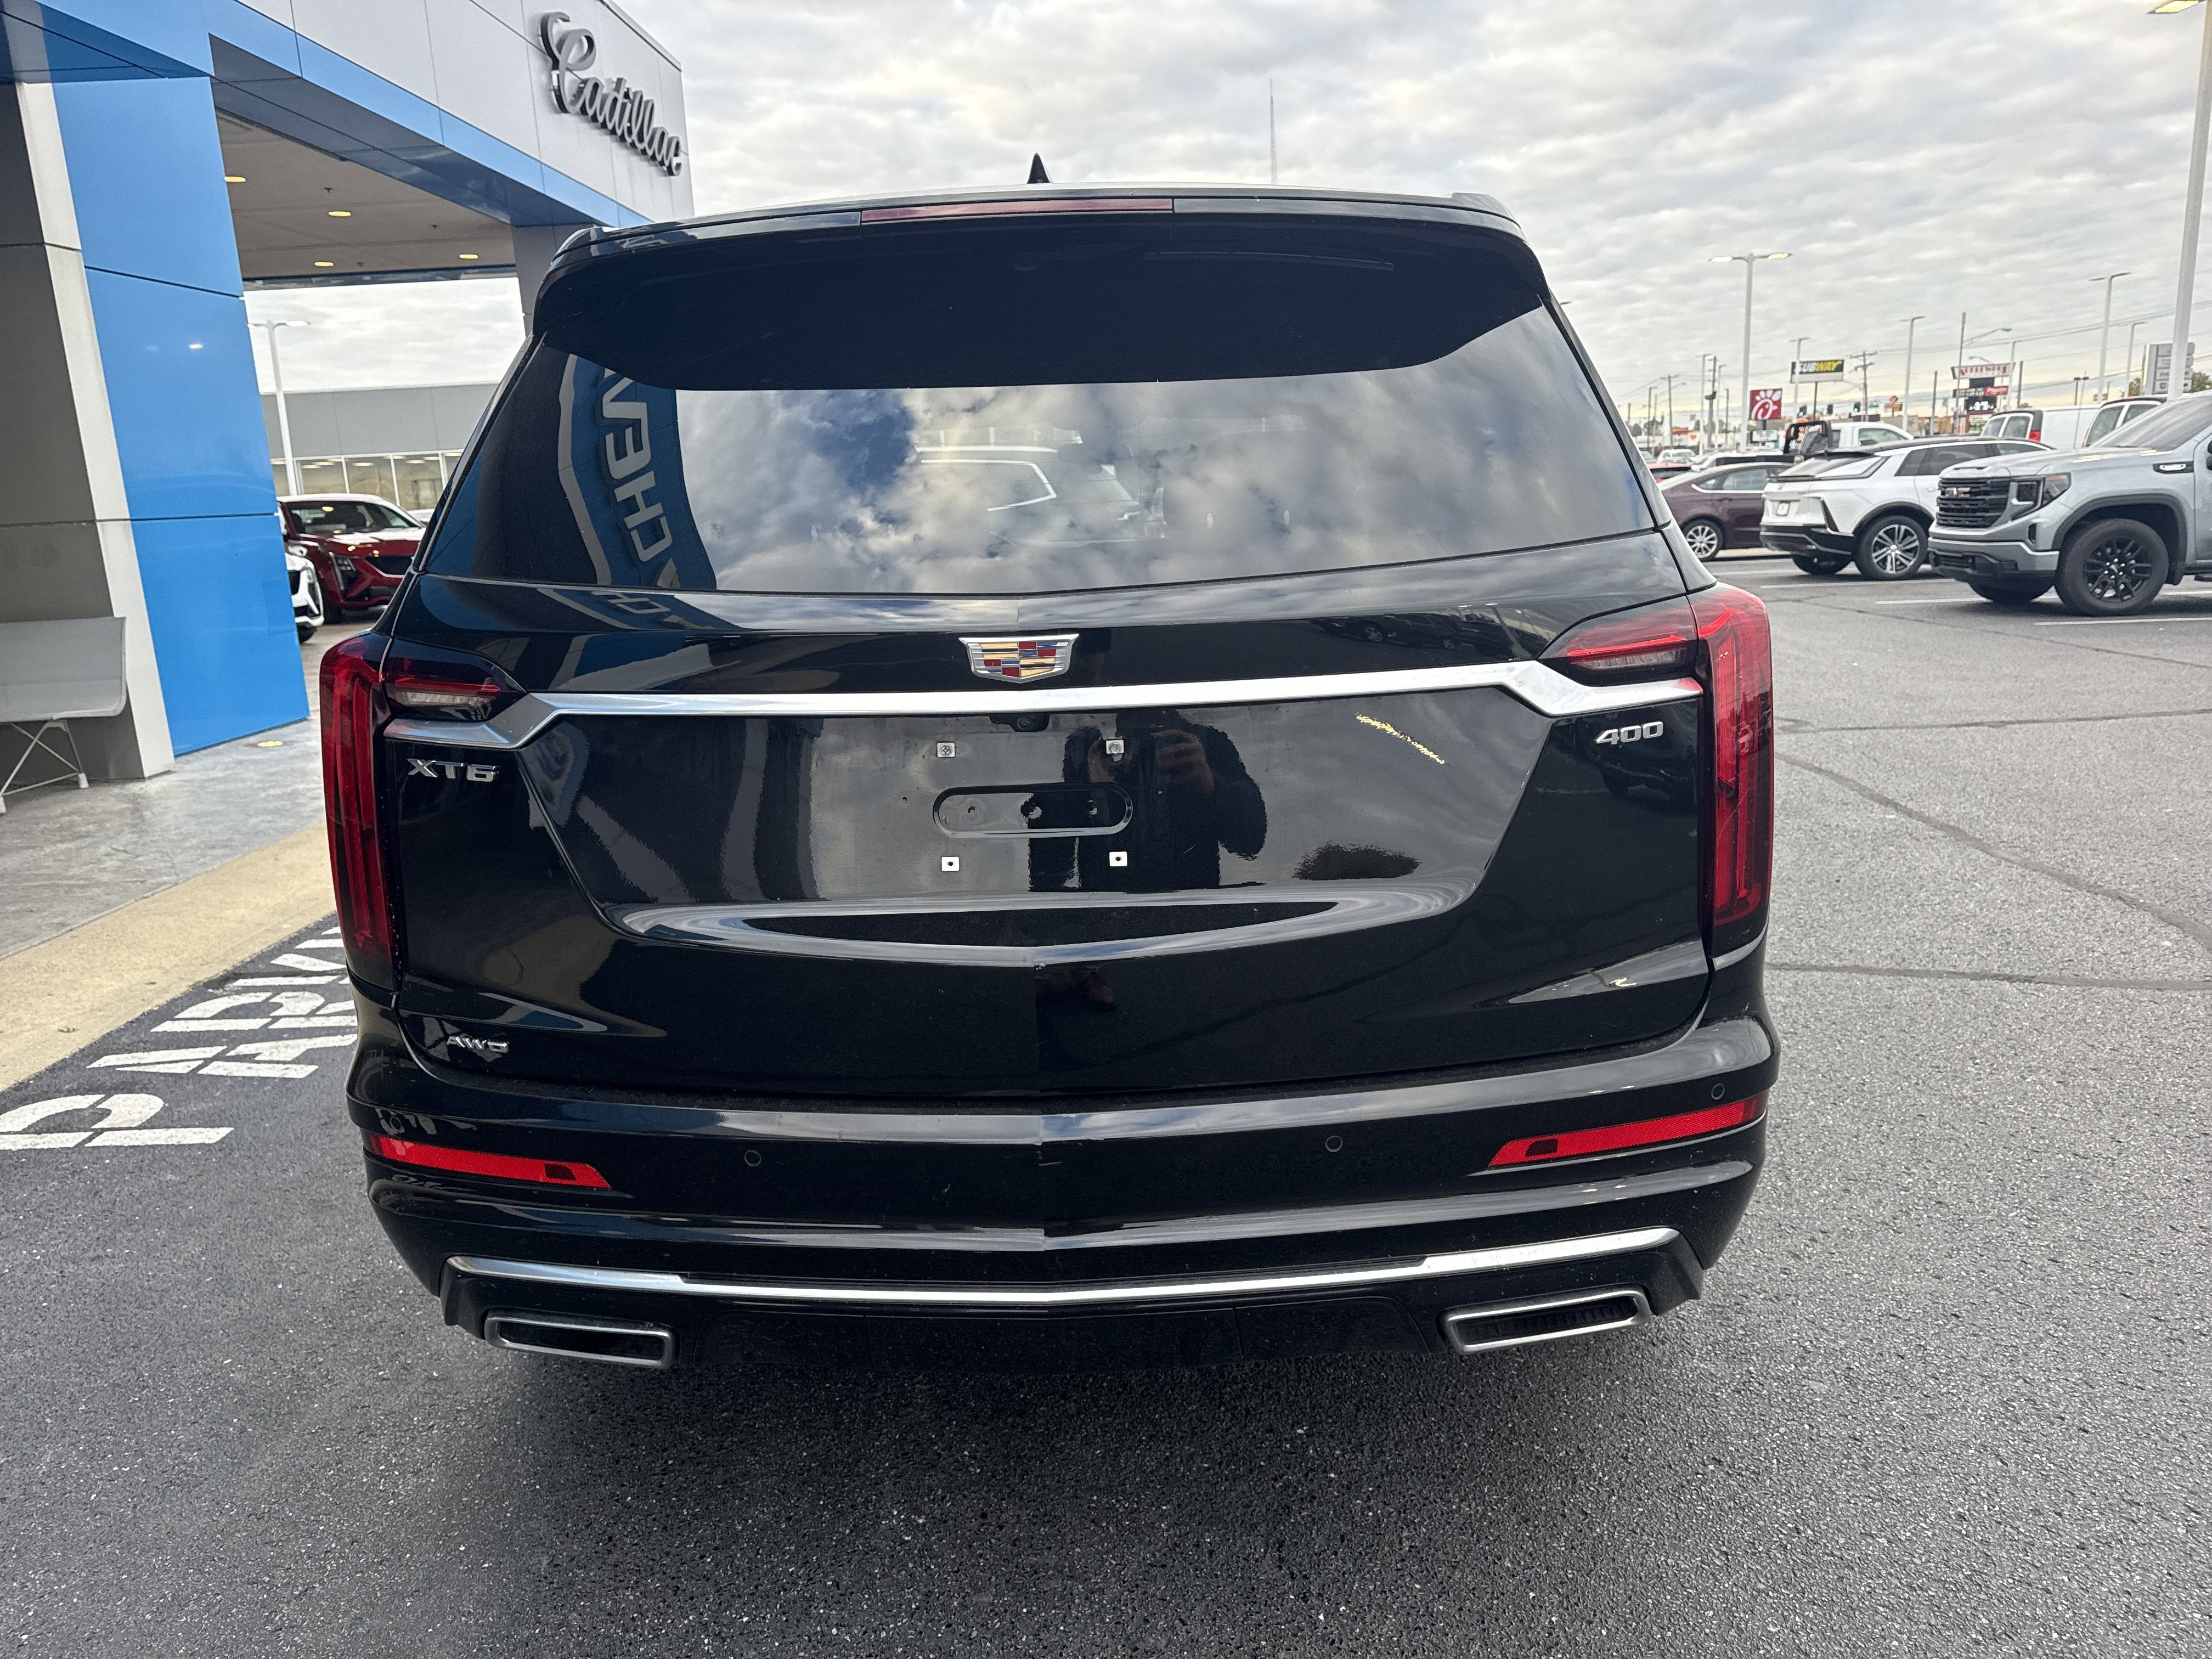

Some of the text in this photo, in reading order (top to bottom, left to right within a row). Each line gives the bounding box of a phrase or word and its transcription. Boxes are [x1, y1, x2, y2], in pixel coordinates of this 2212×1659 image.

[540, 12, 682, 176] Cadillac
[1596, 721, 1663, 745] 400
[407, 758, 497, 782] XT6
[447, 1036, 509, 1053] AWD
